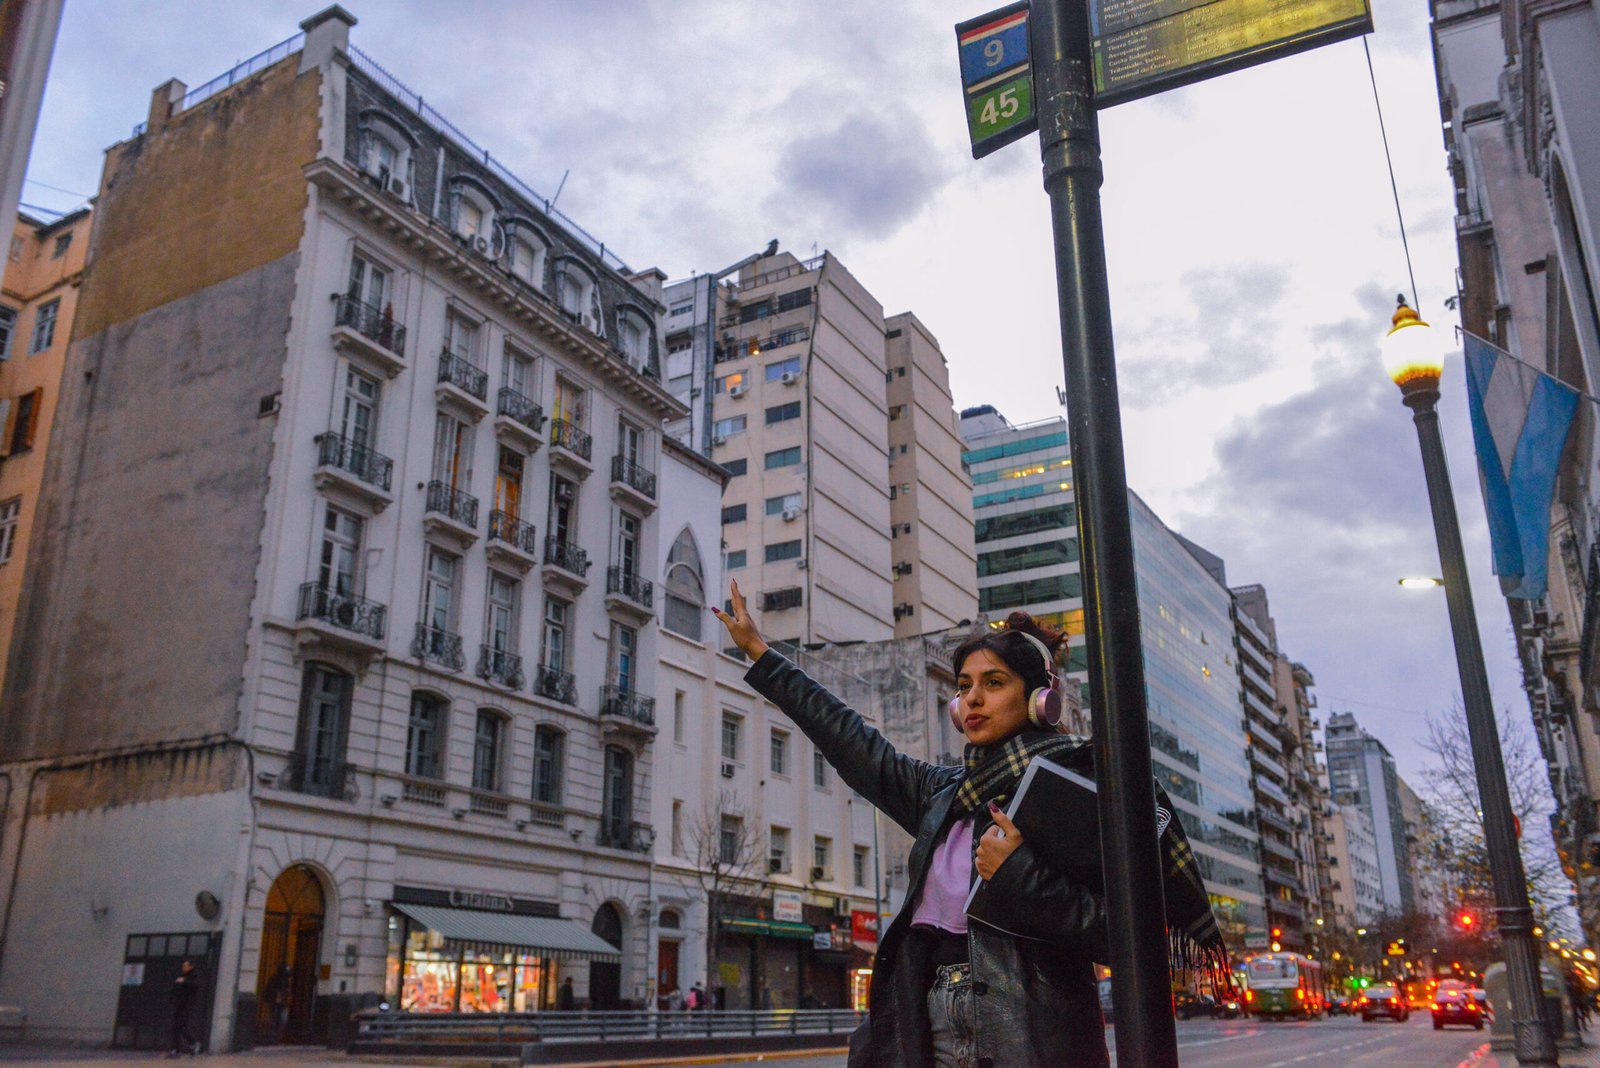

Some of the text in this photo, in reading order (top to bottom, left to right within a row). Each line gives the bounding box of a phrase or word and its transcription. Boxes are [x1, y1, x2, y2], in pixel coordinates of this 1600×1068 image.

[1106, 31, 1130, 45] Ciudad
[1130, 20, 1174, 36] Universitaria
[1107, 36, 1148, 52] Tierra Santa
[1108, 45, 1147, 60] Aeroparque
[984, 39, 1004, 68] 9
[1108, 49, 1160, 67] Costa Salguero
[1145, 54, 1167, 65] Retiro
[1110, 69, 1140, 82] Terminal
[1140, 66, 1150, 74] de
[980, 88, 1019, 126] 45
